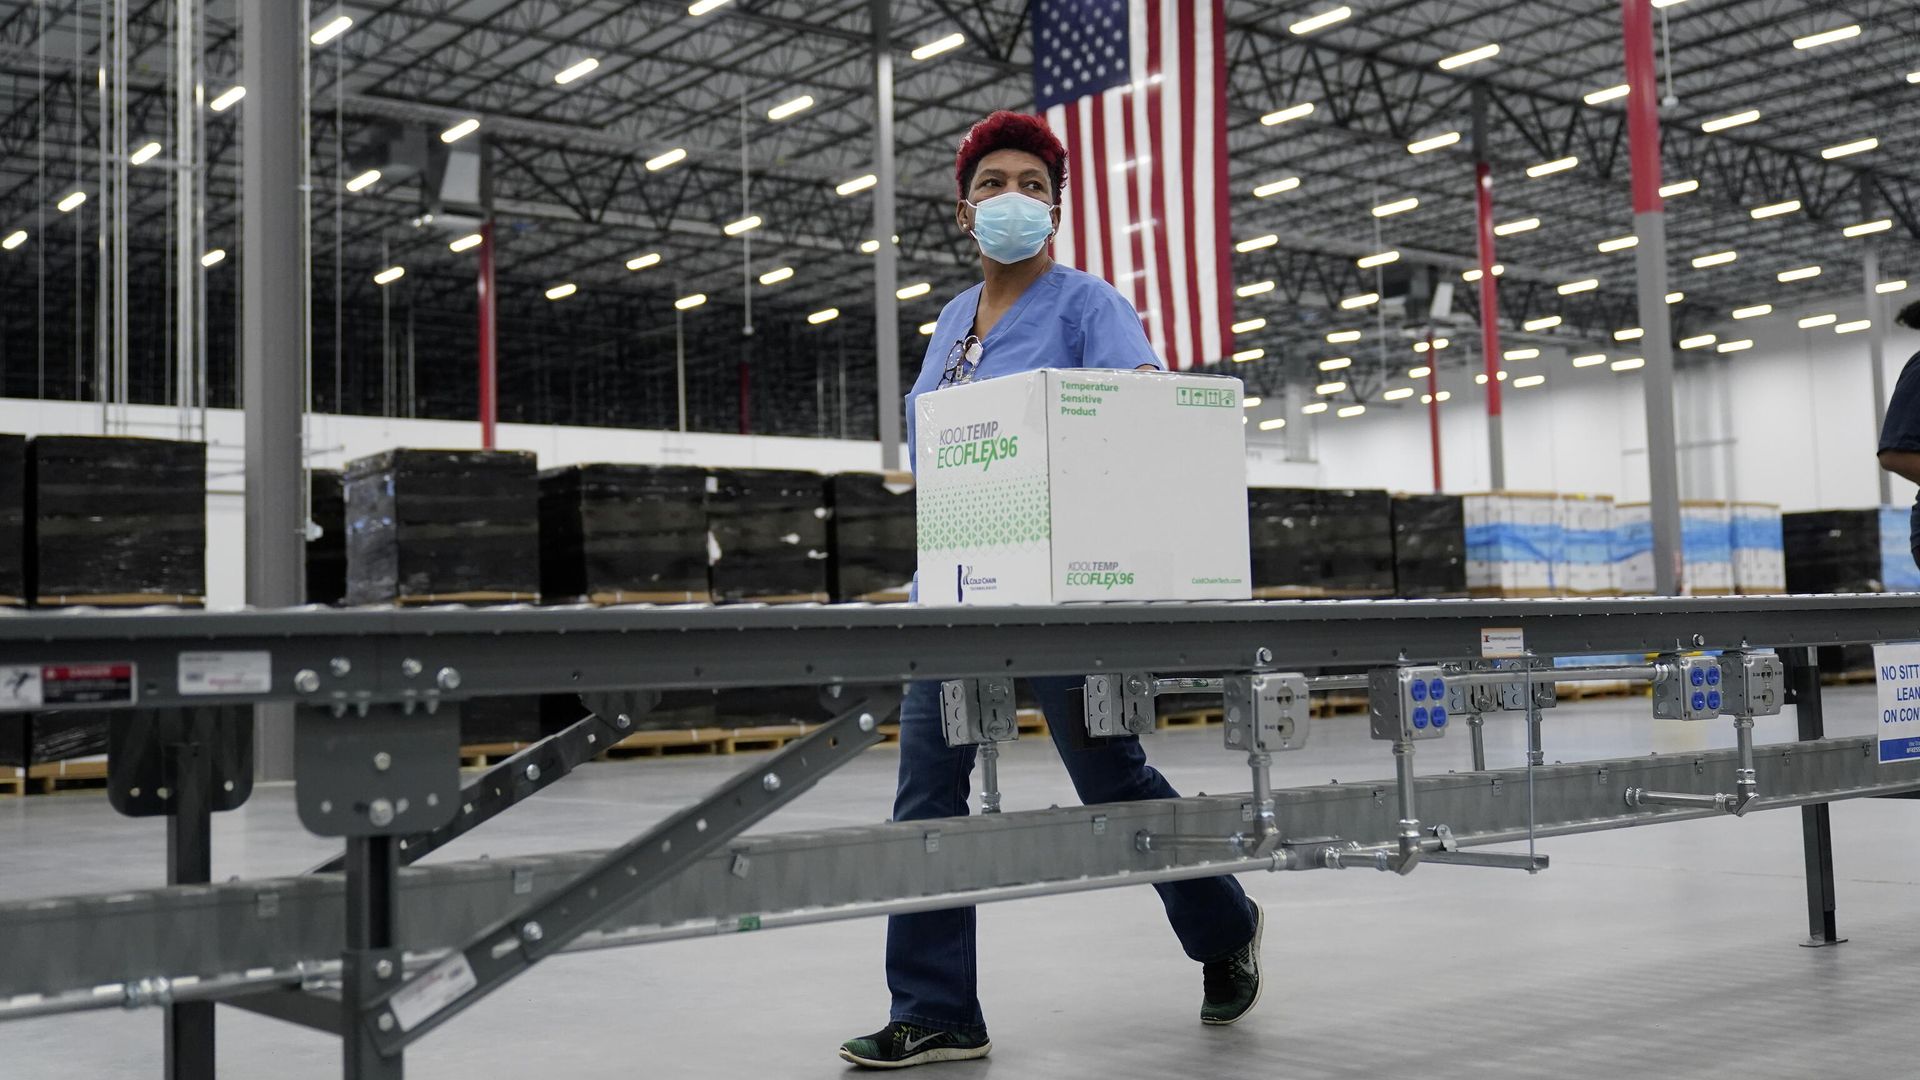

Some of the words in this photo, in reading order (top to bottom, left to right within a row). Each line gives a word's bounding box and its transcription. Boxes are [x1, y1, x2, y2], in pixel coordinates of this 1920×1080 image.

[1060, 380, 1119, 392] Temperature
[1060, 393, 1103, 404] Sensitive
[1061, 406, 1097, 417] Product
[940, 420, 999, 446] KOOLTEMP
[1067, 561, 1119, 571] KOOLTEMP
[1881, 664, 1897, 681] NO
[1896, 686, 1920, 702] LEAN
[1883, 709, 1898, 724] ON
